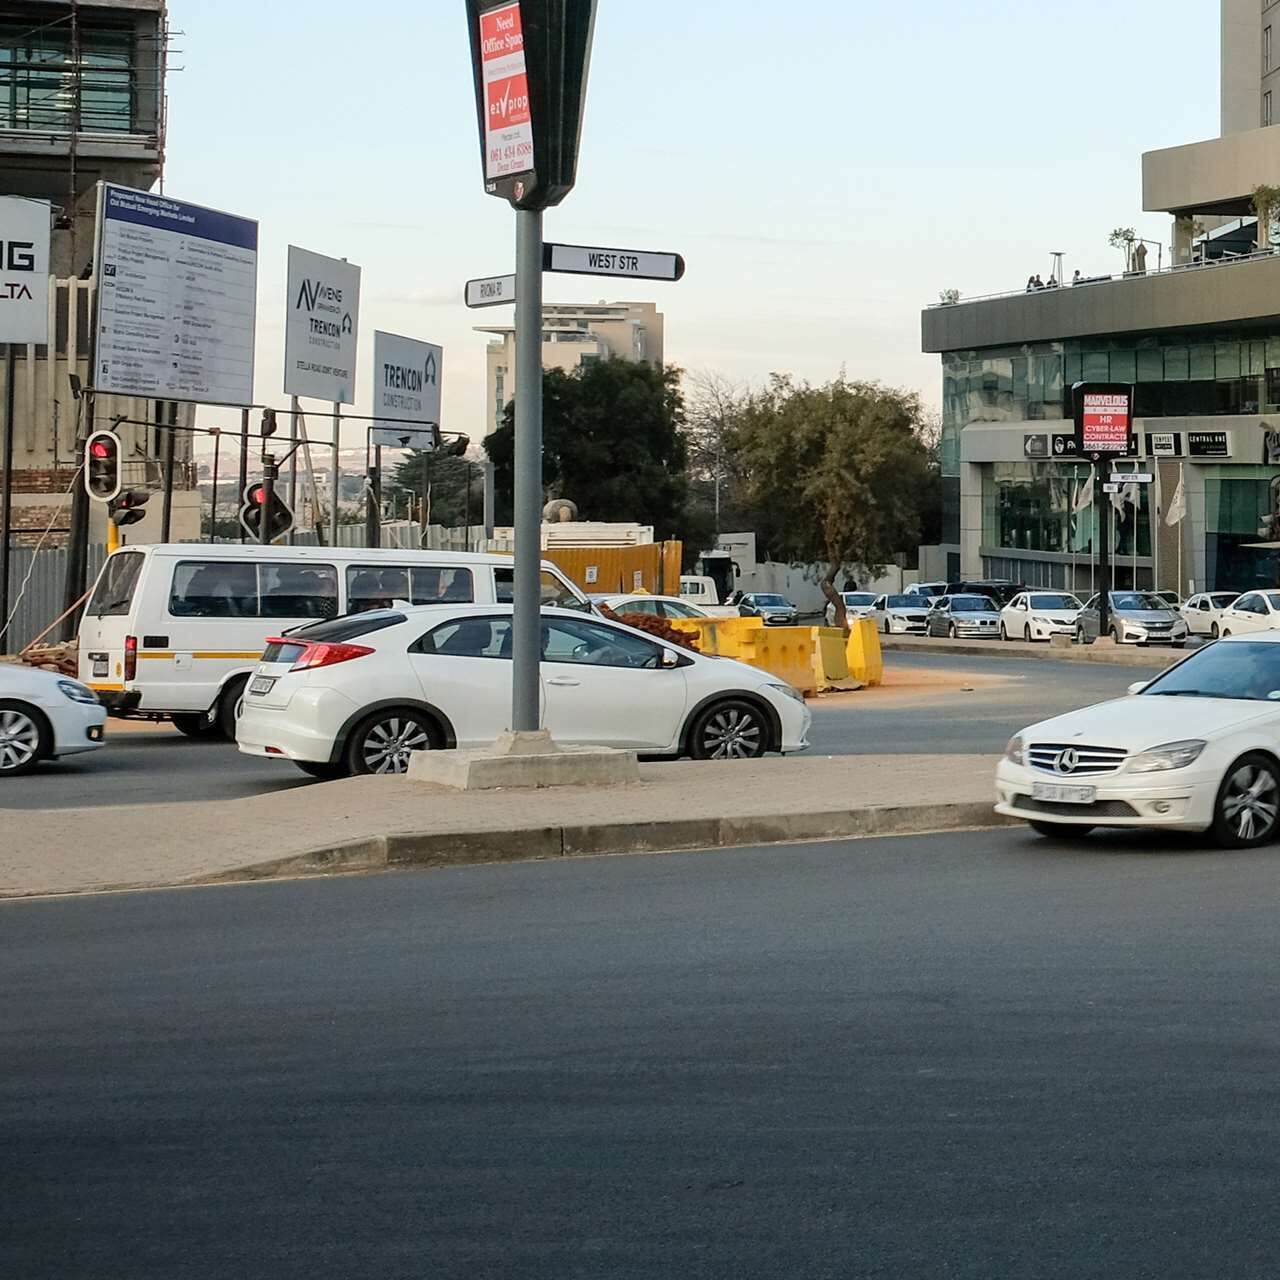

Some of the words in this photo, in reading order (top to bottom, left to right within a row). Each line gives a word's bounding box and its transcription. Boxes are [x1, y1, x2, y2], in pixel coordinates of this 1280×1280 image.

[496, 13, 514, 32] Need
[483, 37, 505, 55] Office
[588, 253, 616, 270] WEST
[619, 255, 638, 271] STR
[310, 318, 340, 337] TRENCON
[384, 364, 422, 392] TRENCON
[383, 393, 422, 411] CONSTRUCTION
[1084, 395, 1128, 407] MARVELOUS
[1099, 416, 1113, 424] HR
